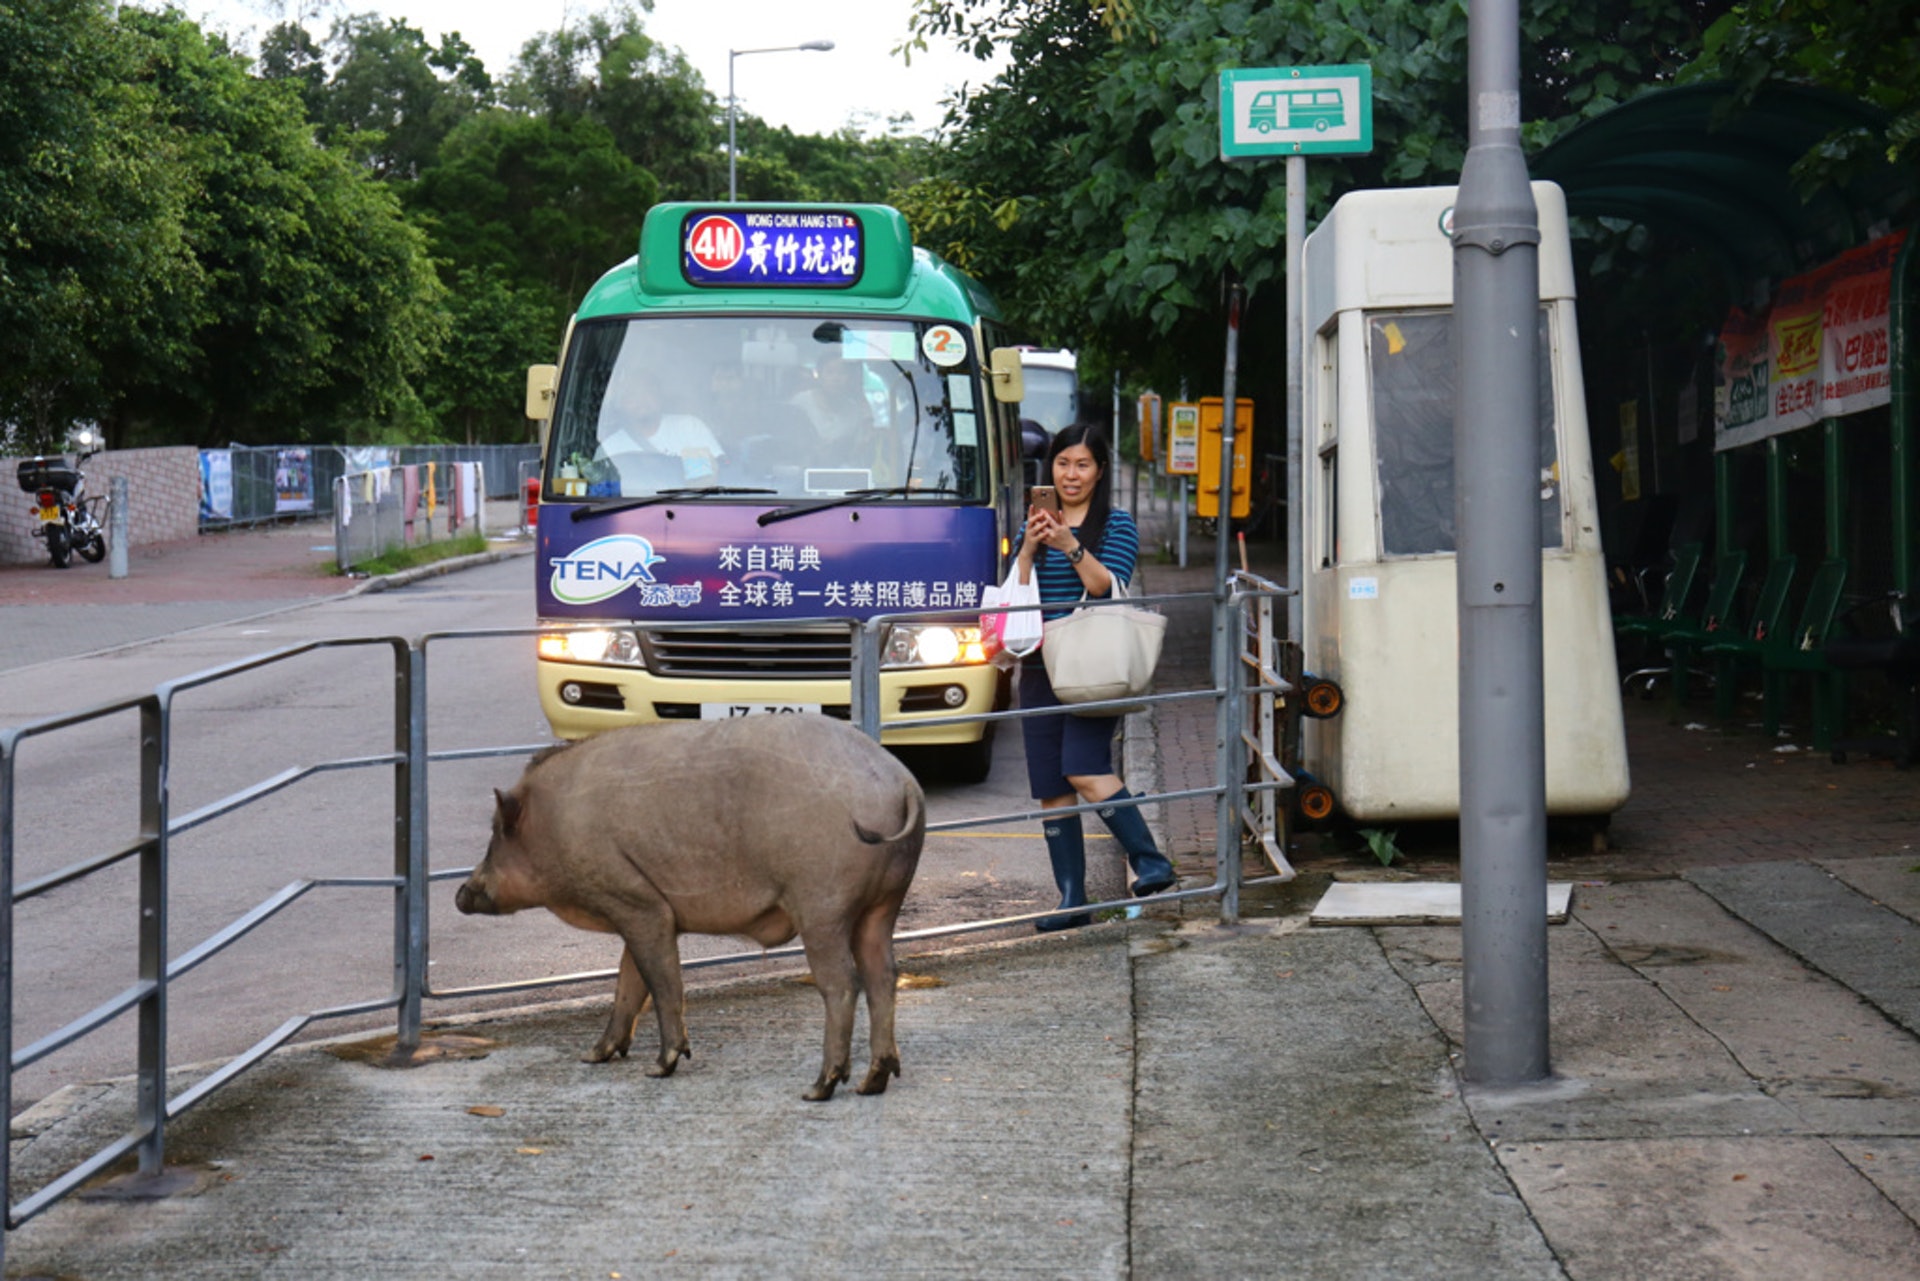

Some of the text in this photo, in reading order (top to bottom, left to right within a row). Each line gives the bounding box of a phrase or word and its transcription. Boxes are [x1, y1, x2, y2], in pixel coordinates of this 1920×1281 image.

[746, 214, 773, 228] WONG
[774, 214, 799, 228] CHUK
[800, 214, 826, 228] HANG
[694, 226, 735, 261] 4M
[745, 230, 857, 276] 黃竹坑站
[551, 559, 654, 581] TENA
[718, 544, 822, 572] 來自瑞典
[718, 580, 978, 608] 全球第一失禁照護品牌
